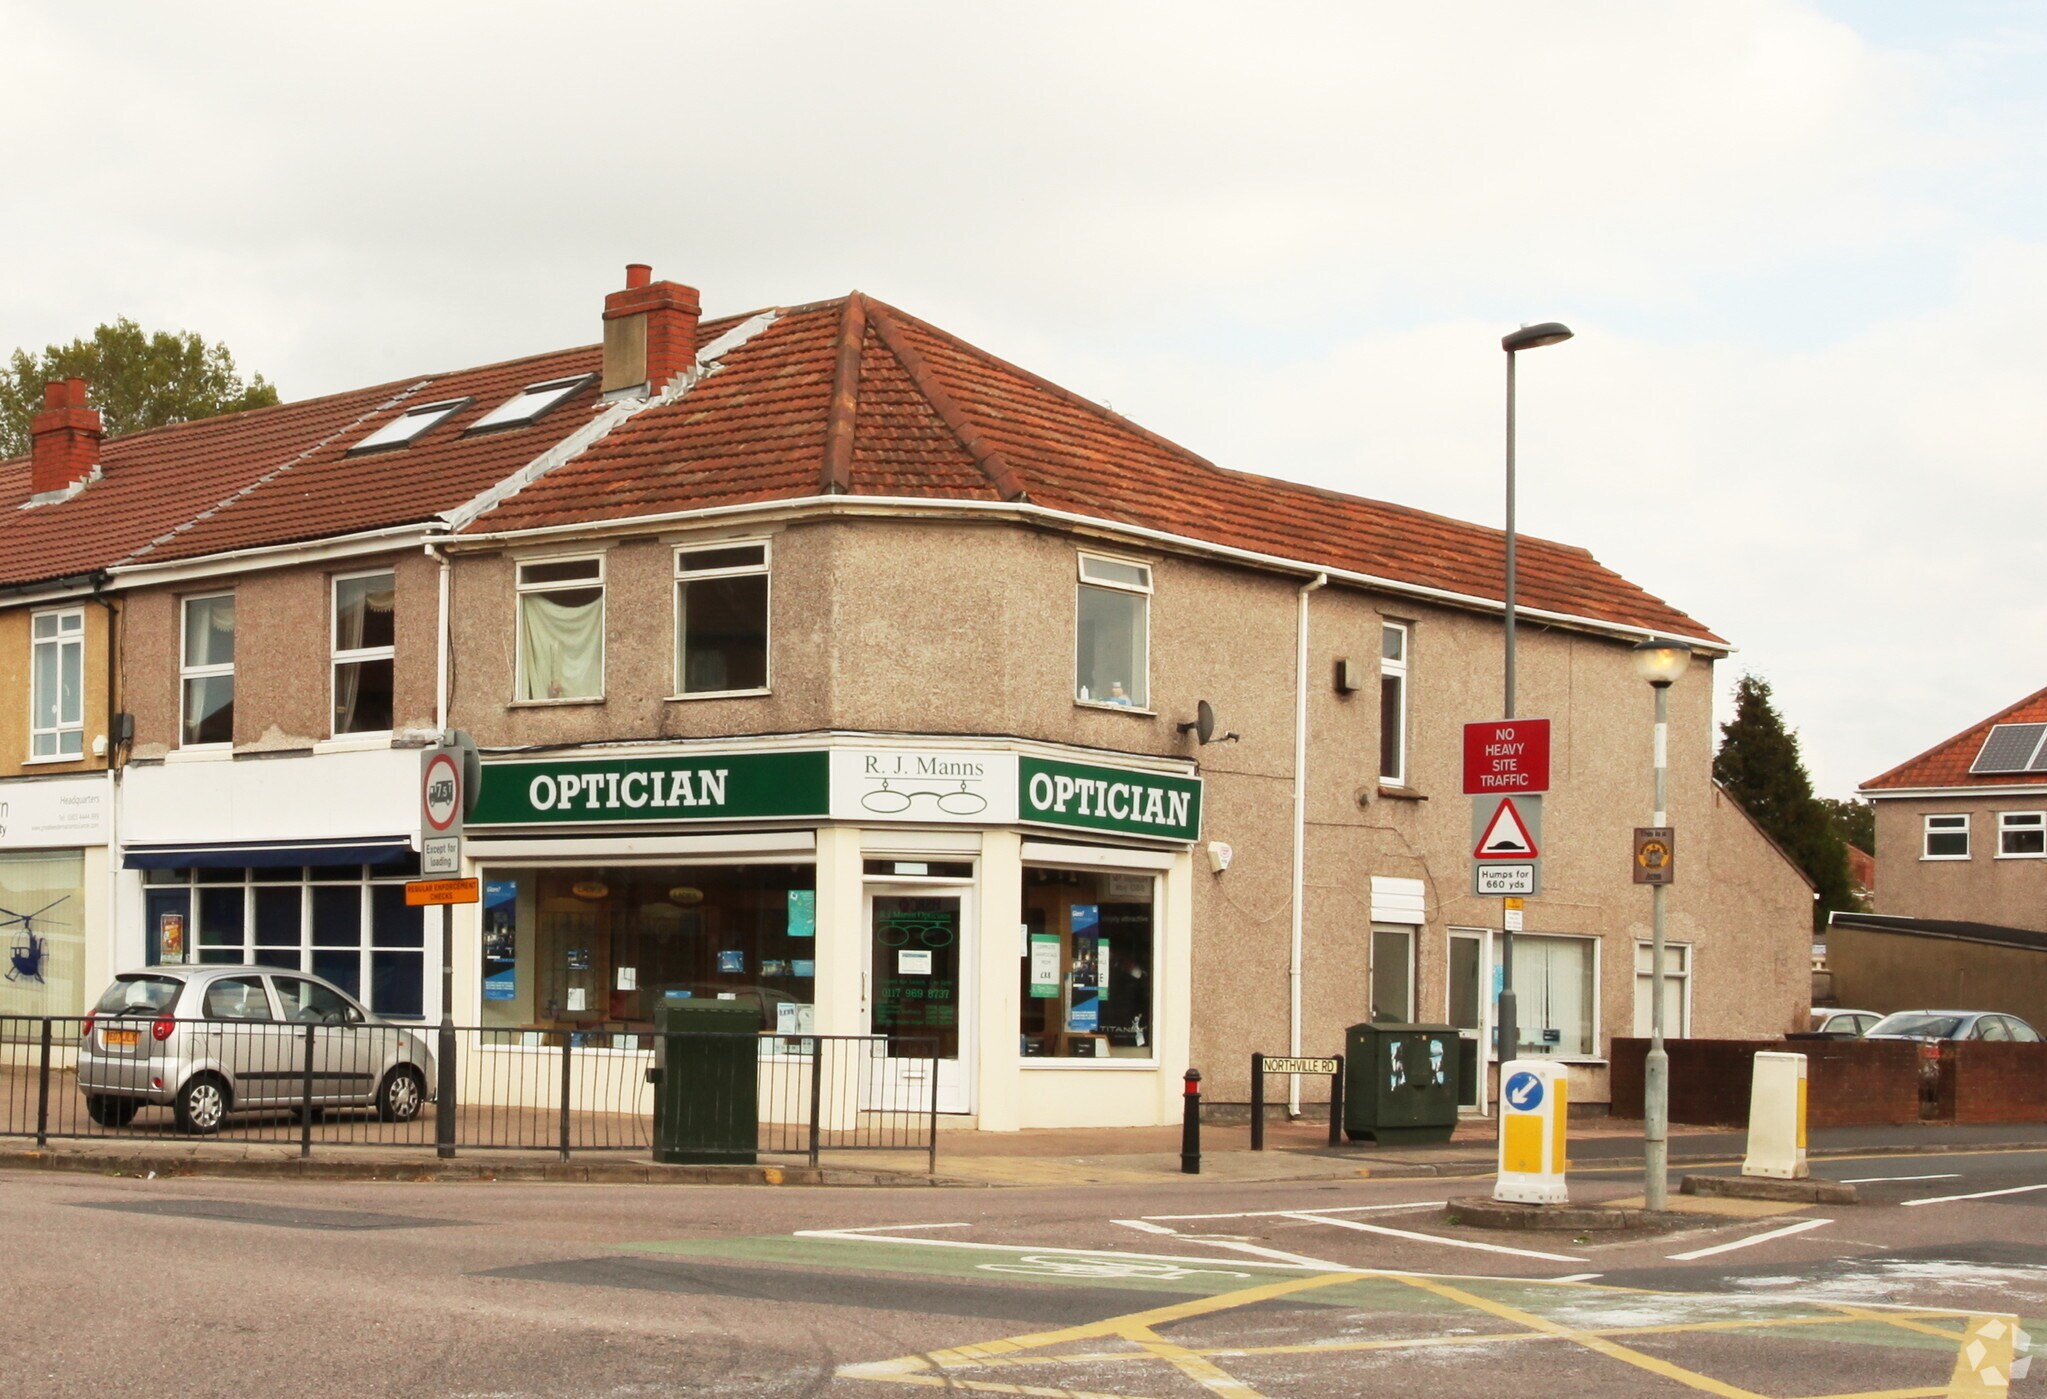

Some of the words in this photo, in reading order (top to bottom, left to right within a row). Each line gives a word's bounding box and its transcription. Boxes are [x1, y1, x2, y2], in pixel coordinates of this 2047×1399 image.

[1495, 728, 1515, 740] NO
[1485, 743, 1525, 756] HEAVY
[865, 755, 886, 774] R.
[893, 756, 908, 775] J.
[916, 757, 984, 776] Manns
[1492, 758, 1518, 772] SITE
[1480, 773, 1529, 787] TRAFFIC
[529, 769, 729, 811] OPTICIAN
[60, 795, 100, 807] Headquarters
[1029, 772, 1191, 827] OPTICIAN
[426, 843, 447, 855] Except
[447, 842, 457, 853] for
[430, 856, 452, 868] loading
[1482, 871, 1513, 879] Humps
[1516, 870, 1529, 879] for
[1486, 880, 1505, 889] 660
[1509, 881, 1525, 890] yds
[429, 892, 453, 901] CHECKS
[882, 988, 901, 998] 0117
[905, 988, 924, 998] 969
[927, 989, 950, 999] 8737
[1264, 1059, 1318, 1072] NORTHVILLE
[1321, 1060, 1334, 1073] RD
